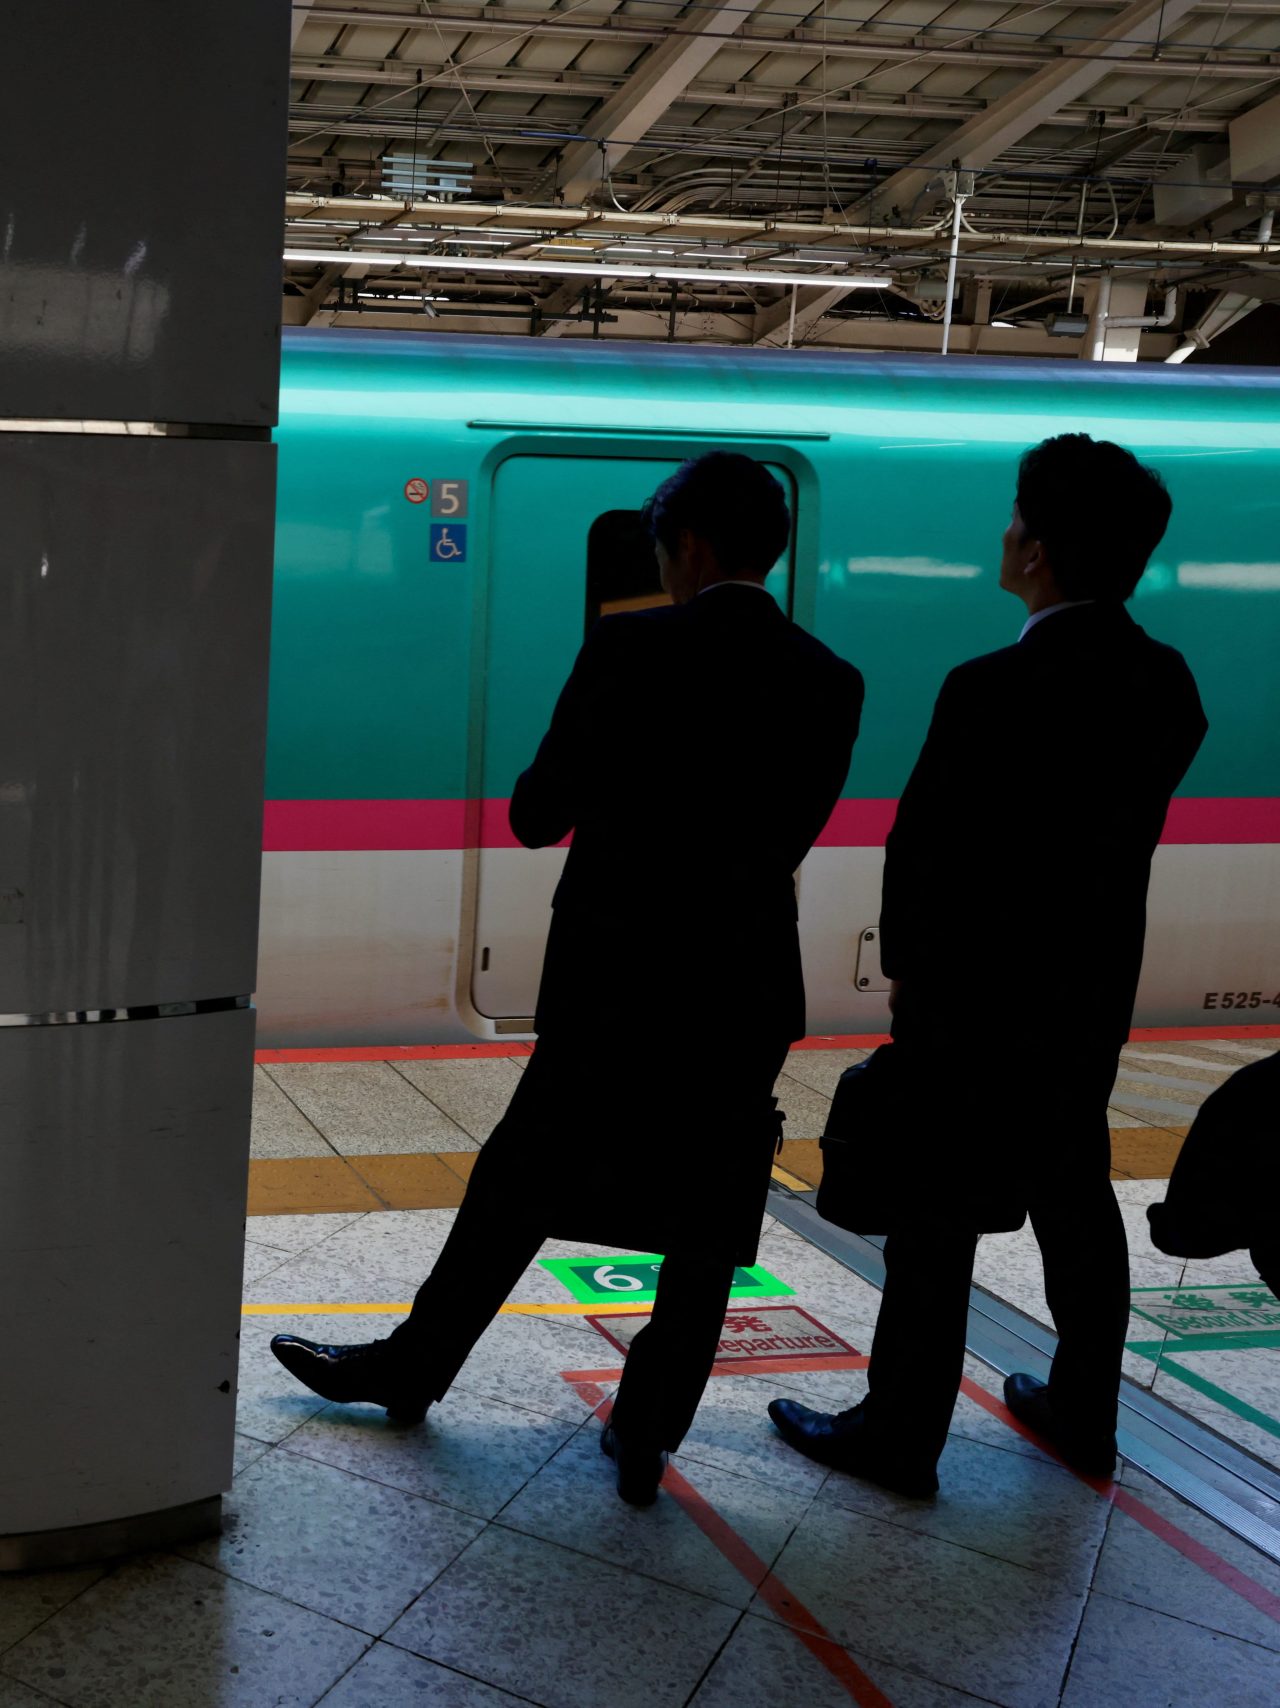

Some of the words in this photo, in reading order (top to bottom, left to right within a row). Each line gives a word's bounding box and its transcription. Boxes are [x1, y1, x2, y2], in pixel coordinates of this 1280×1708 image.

[440, 483, 460, 514] 5
[593, 1265, 644, 1292] 6
[1157, 1311, 1255, 1330] Second
[713, 1335, 837, 1356] eparture
